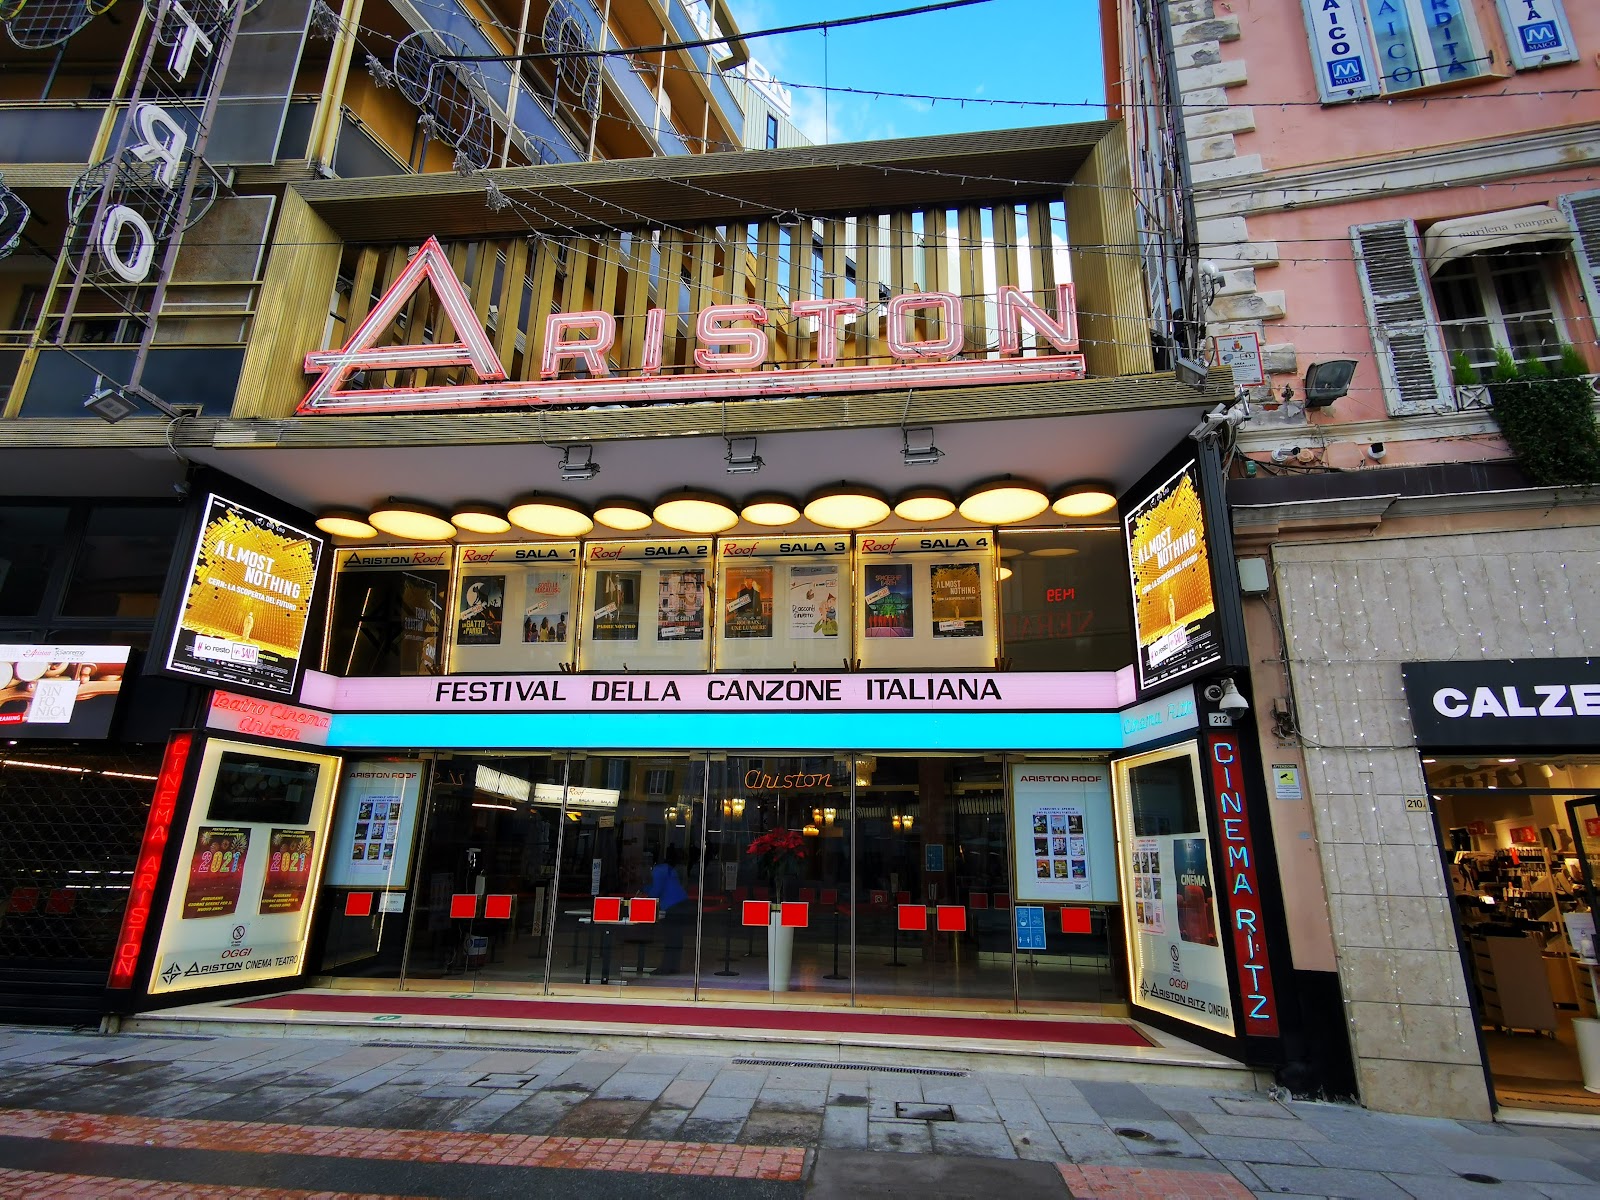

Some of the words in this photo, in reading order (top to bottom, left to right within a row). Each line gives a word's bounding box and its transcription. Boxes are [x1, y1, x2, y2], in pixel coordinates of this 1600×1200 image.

[1528, 40, 1558, 51] MAICO
[1335, 75, 1361, 87] MAICO
[1458, 224, 1509, 238] marilena
[1514, 216, 1559, 230] margari
[590, 545, 626, 562] Roof
[644, 546, 690, 556] SALA
[696, 545, 708, 555] 2
[722, 542, 759, 558] Roof
[779, 542, 825, 553] SALA
[834, 541, 846, 552] 3
[861, 537, 898, 555] Roof
[920, 538, 969, 549] SALA
[976, 537, 989, 548] 4
[1138, 526, 1172, 565] ALMOST
[1157, 528, 1196, 570] NOTHING
[214, 540, 275, 573] ALMOST
[411, 551, 447, 567] Roof
[463, 549, 498, 565] Roof
[515, 549, 559, 559] SALA
[570, 548, 577, 557] 1
[244, 567, 301, 598] NOTHING
[936, 580, 961, 589] ALMOST
[950, 586, 976, 595] NOTHING
[208, 577, 228, 589] CERN:
[227, 583, 236, 591] LA
[236, 585, 265, 601] SCOPERTA
[265, 595, 276, 604] DEL
[276, 599, 297, 611] FUTURO
[212, 645, 230, 654] resto
[241, 648, 255, 660] SALA
[40, 686, 63, 696] SIN
[435, 681, 567, 702] FESTIVAL
[591, 680, 681, 701] DELLA
[707, 679, 842, 701] CANZONE
[866, 678, 1003, 701] ITALIANA
[39, 697, 55, 706] FO
[1433, 684, 1600, 718] CALZE
[35, 706, 66, 717] NICA
[270, 705, 330, 728] Cinema
[1213, 715, 1228, 724] 212
[1020, 775, 1069, 783] ARISTON
[151, 739, 187, 841] CINEMA
[1213, 742, 1253, 895] CINEMA
[198, 850, 241, 873] 2021
[270, 851, 306, 872] 2021
[1181, 874, 1207, 887] CINEMA
[115, 855, 159, 976] ARISTON
[221, 948, 253, 959] OGGI
[183, 961, 243, 977] ARISTON
[245, 958, 272, 970] CINEMA
[274, 955, 298, 967] TEATRO
[1235, 908, 1270, 1020] RITZ
[1168, 977, 1189, 990] OGGI
[1150, 982, 1186, 1004] ARISTON
[1187, 997, 1206, 1011] RITZ
[1208, 1002, 1230, 1019] CINEMA
